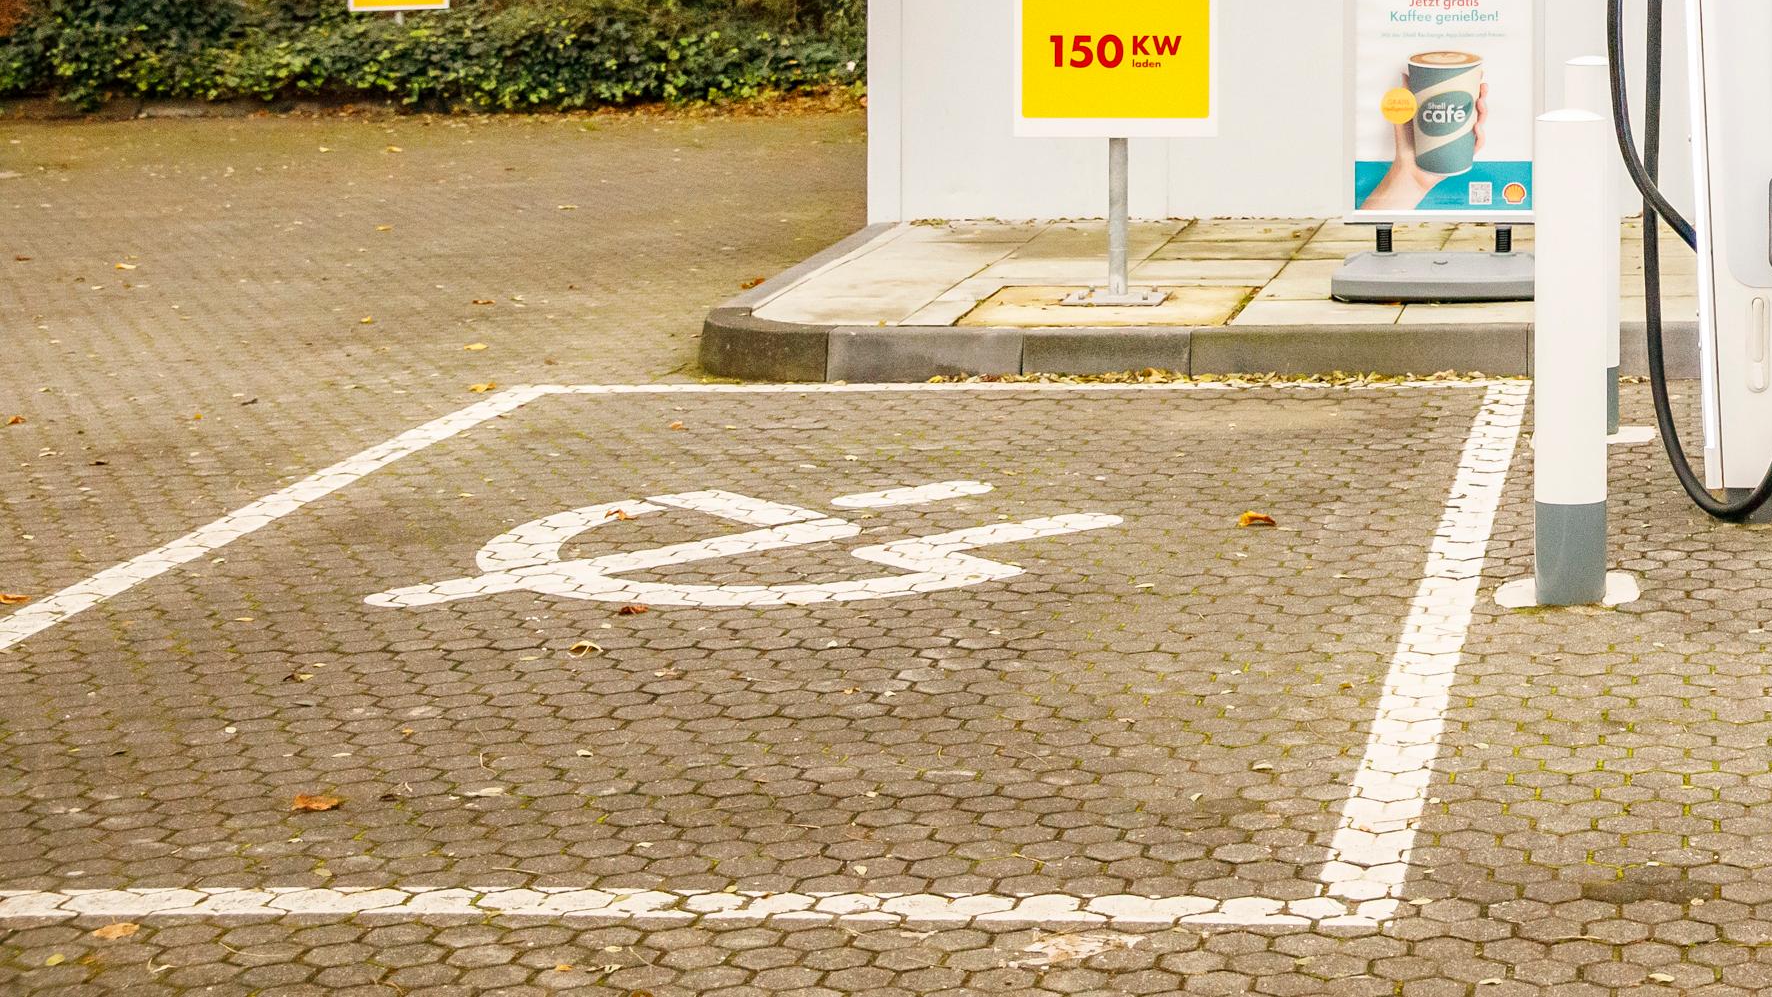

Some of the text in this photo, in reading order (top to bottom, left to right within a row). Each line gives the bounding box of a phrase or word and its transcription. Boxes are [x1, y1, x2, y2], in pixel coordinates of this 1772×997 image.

[1390, 10, 1499, 25] Kaffee genießen!
[1049, 34, 1182, 69] 150 KW
[1132, 59, 1161, 68] laden
[1422, 104, 1466, 123] café
[1427, 102, 1446, 110] Shell
